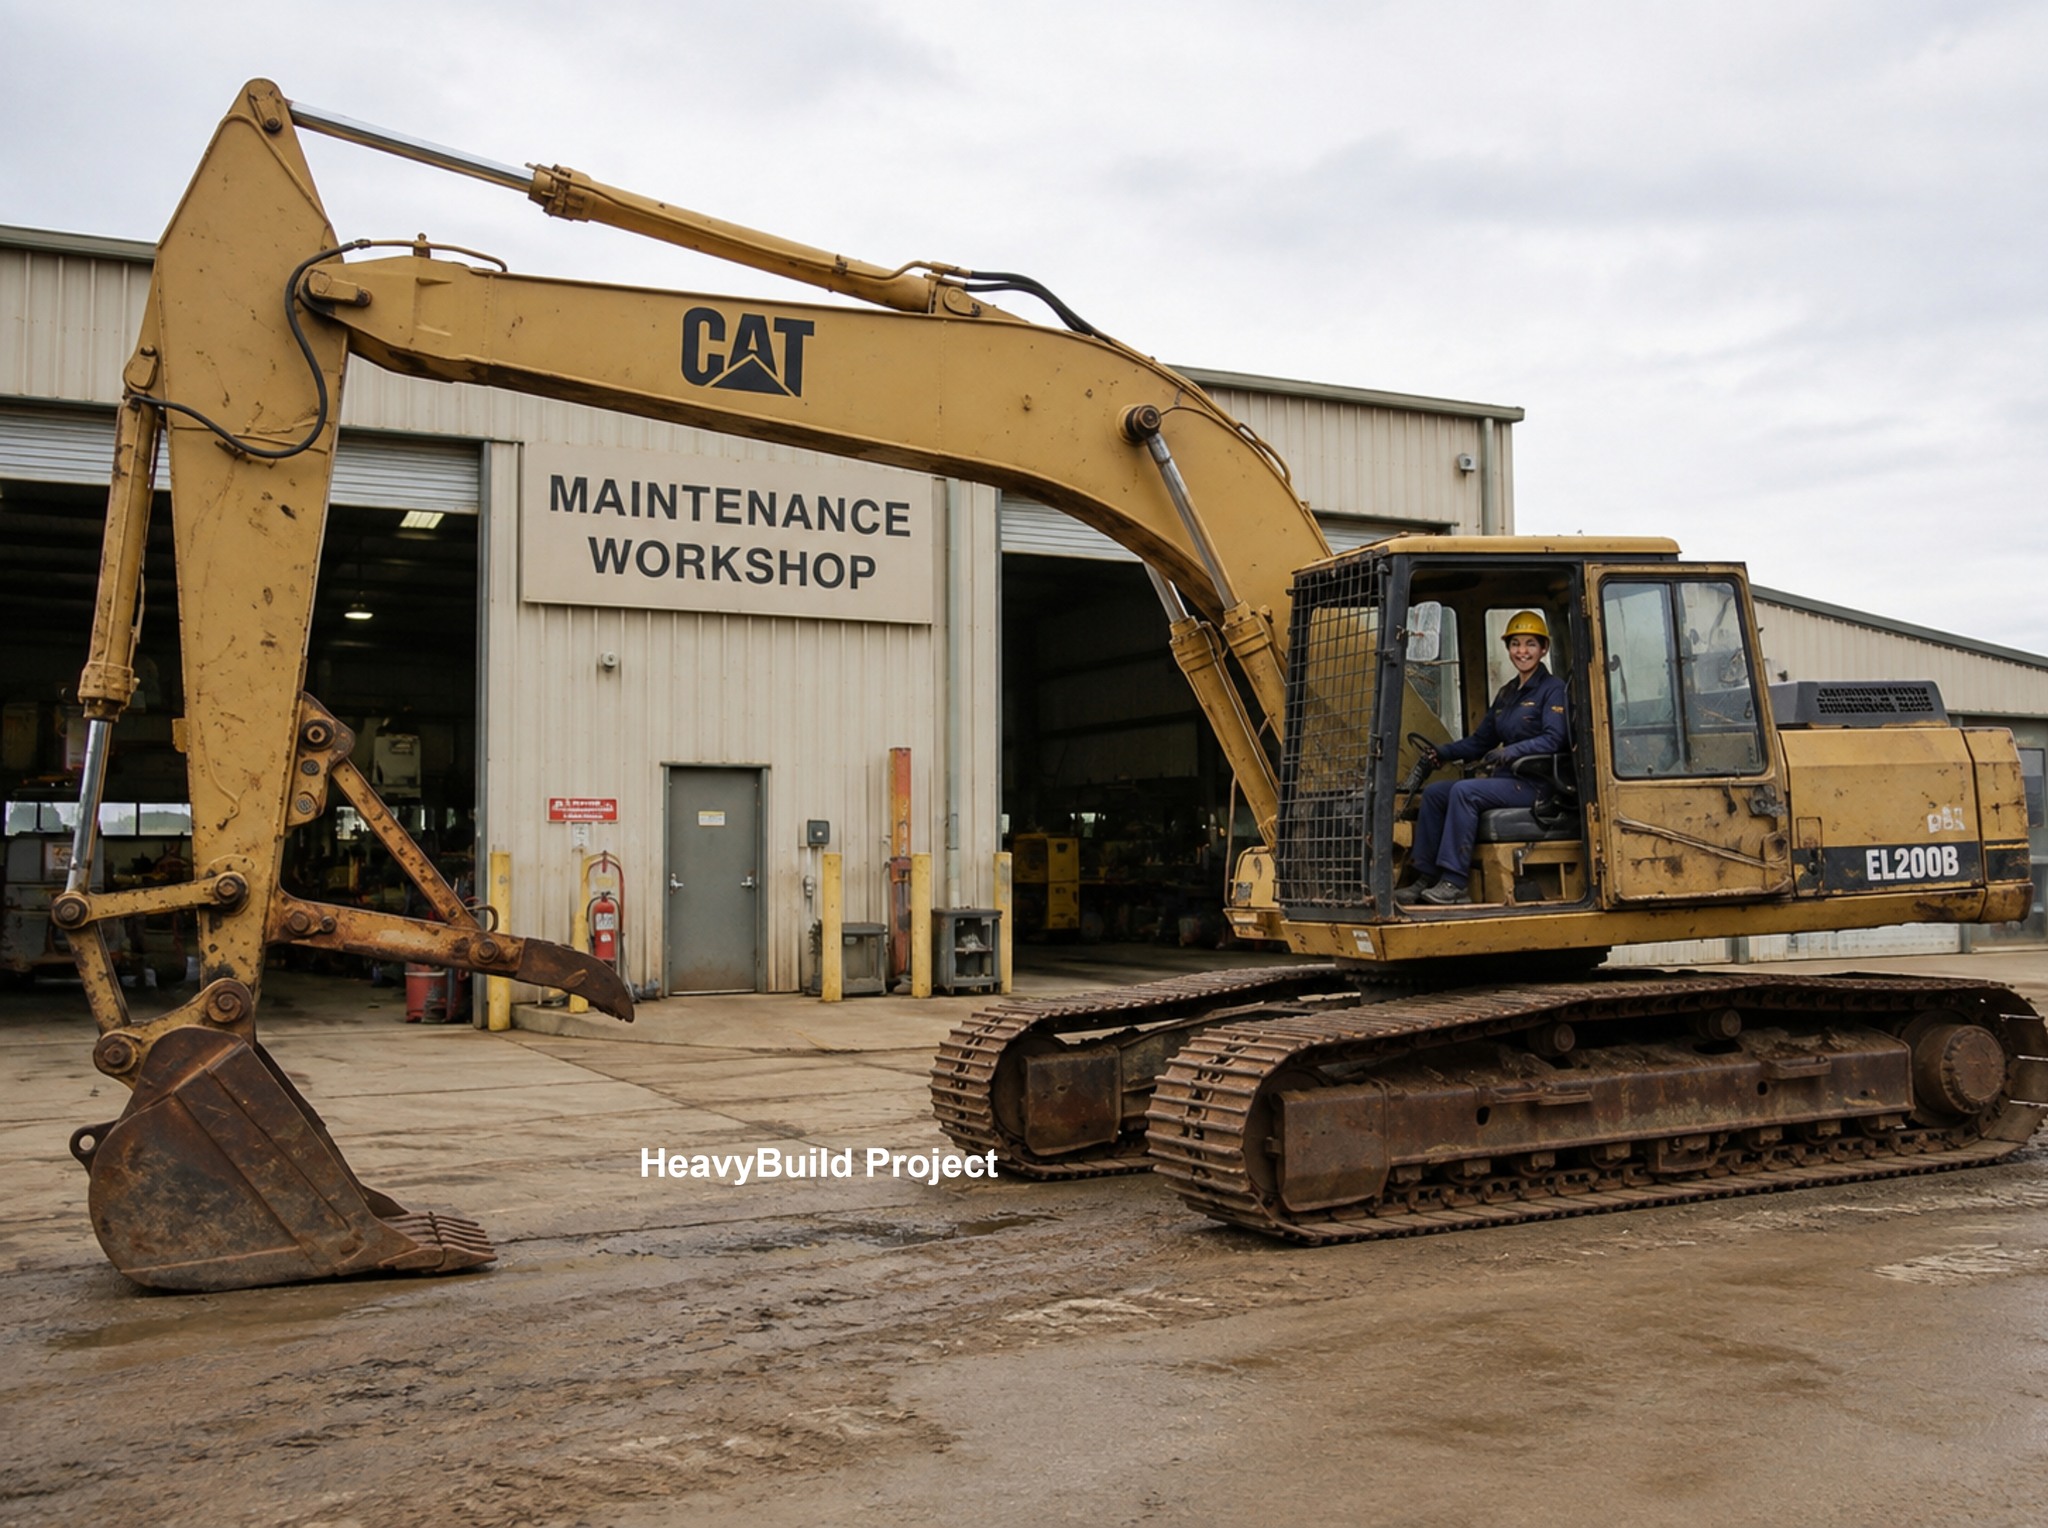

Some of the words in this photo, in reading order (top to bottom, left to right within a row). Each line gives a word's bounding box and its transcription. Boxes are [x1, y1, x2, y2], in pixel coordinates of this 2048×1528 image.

[682, 306, 815, 398] CAT
[549, 474, 912, 537] MAINTENANCE
[588, 536, 877, 590] WORKSHOP
[1866, 846, 1960, 881] EL200B
